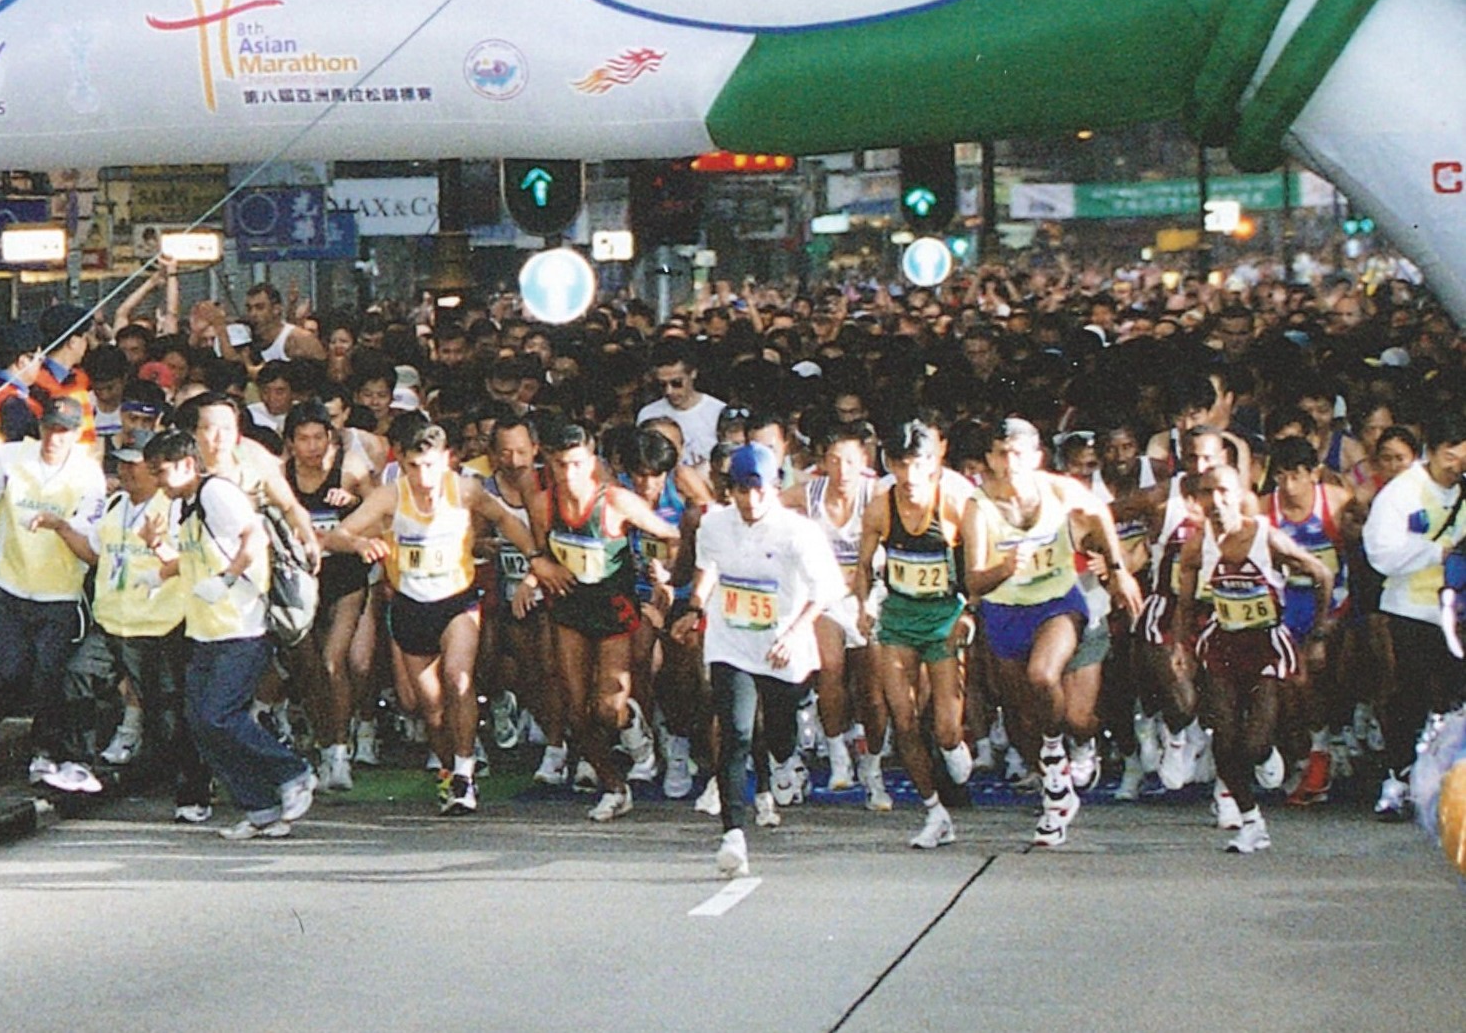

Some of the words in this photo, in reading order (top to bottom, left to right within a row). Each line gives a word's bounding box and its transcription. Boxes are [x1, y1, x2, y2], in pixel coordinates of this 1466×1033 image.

[236, 22, 265, 37] 8th
[238, 37, 297, 54] Asian
[238, 53, 359, 74] Marathon
[917, 567, 942, 586] 22
[725, 590, 738, 614] M
[750, 594, 772, 619] 55
[1242, 601, 1268, 621] 26
